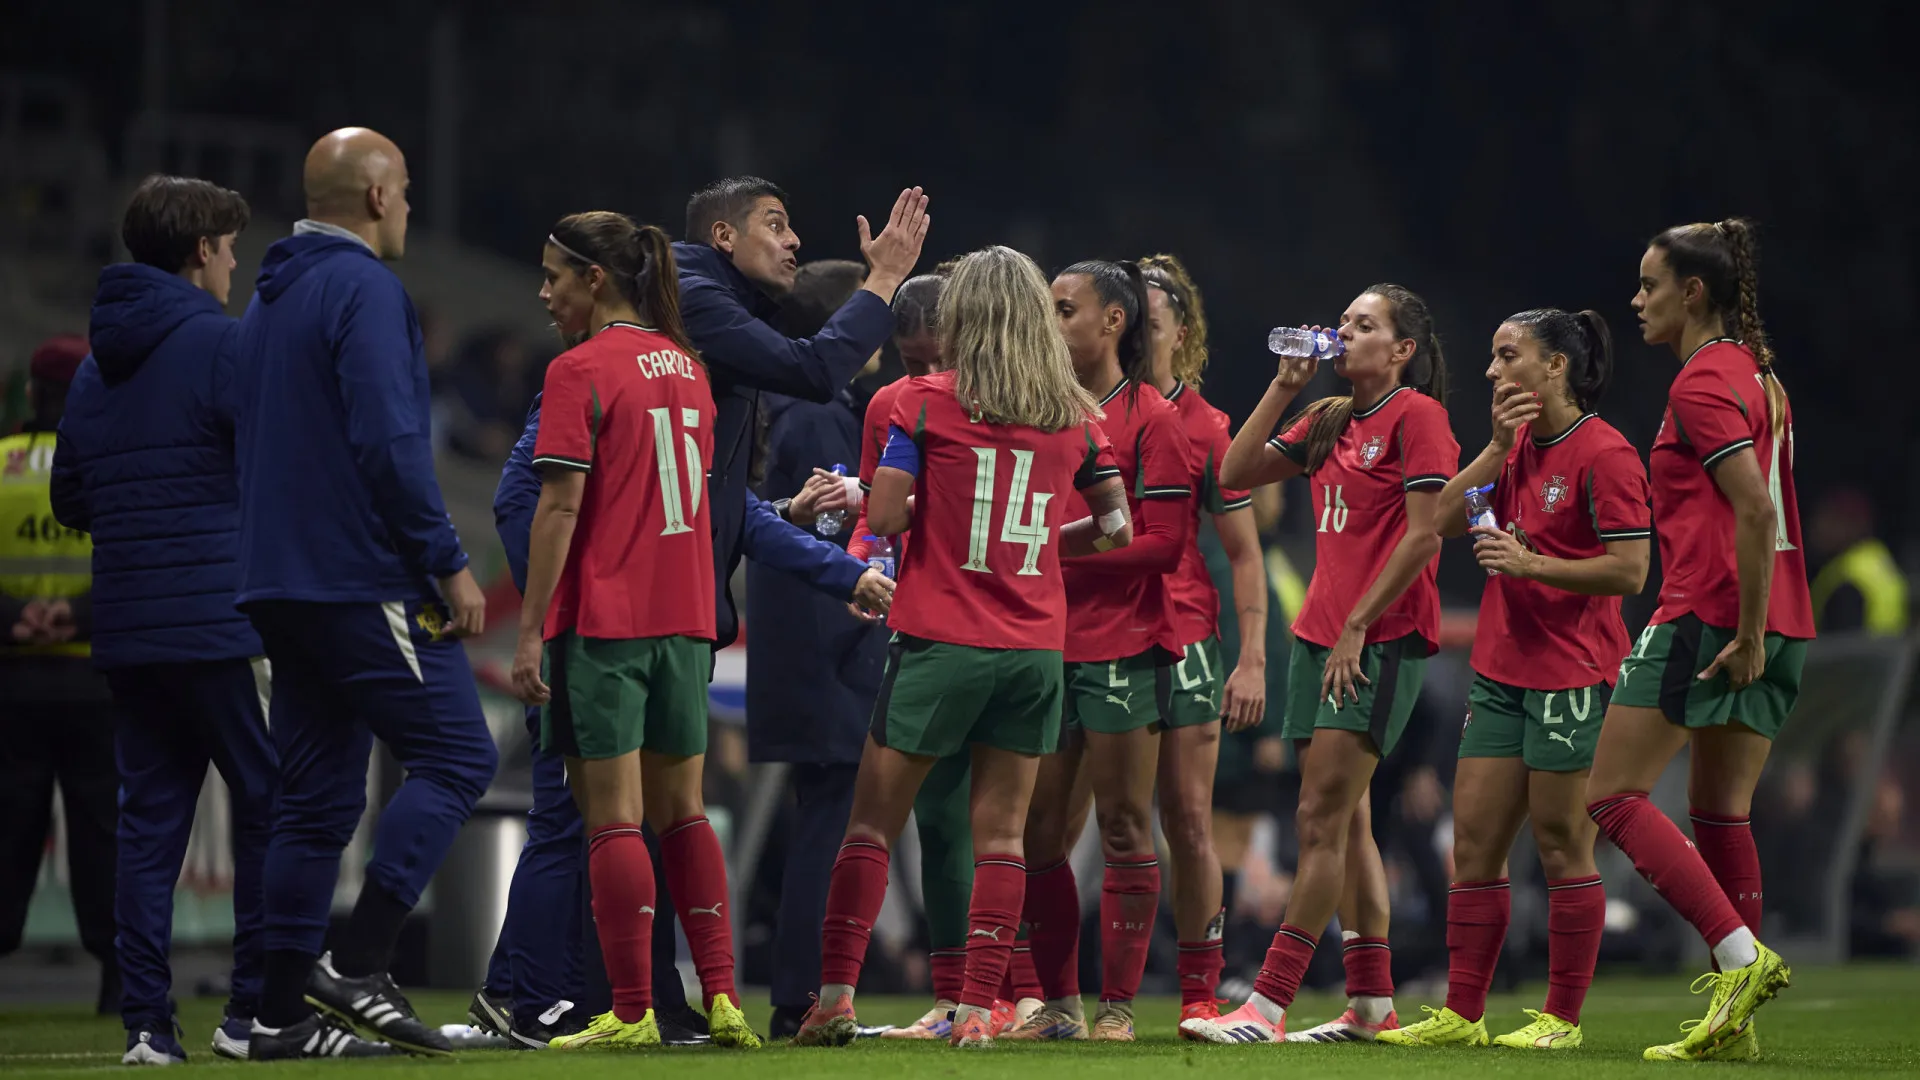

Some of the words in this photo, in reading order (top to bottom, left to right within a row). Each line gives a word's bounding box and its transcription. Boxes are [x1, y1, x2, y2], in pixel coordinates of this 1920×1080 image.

[636, 349, 696, 381] CAROLE
[960, 447, 1055, 576] 14
[1317, 485, 1349, 534] 16
